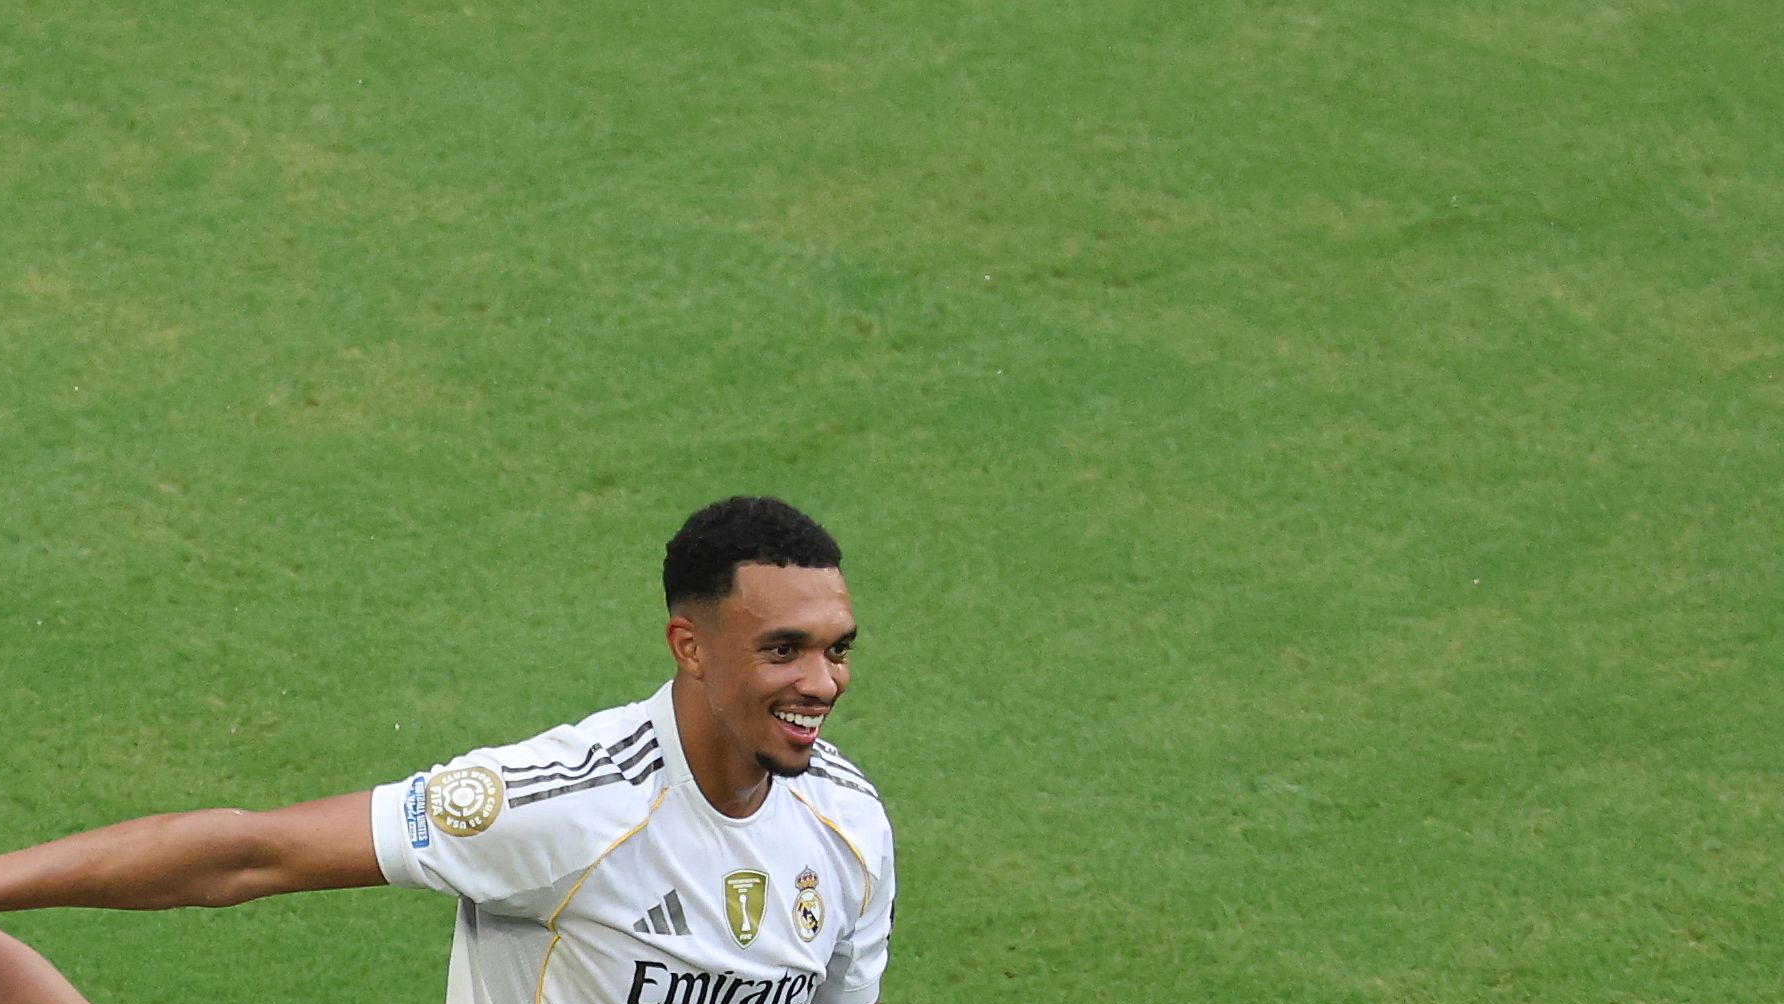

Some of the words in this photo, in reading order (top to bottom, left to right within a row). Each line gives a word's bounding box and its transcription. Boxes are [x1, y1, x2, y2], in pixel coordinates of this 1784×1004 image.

[470, 770, 496, 795] WORLD
[430, 785, 443, 817] FIFA
[482, 797, 496, 818] CUP
[446, 816, 468, 829] USA
